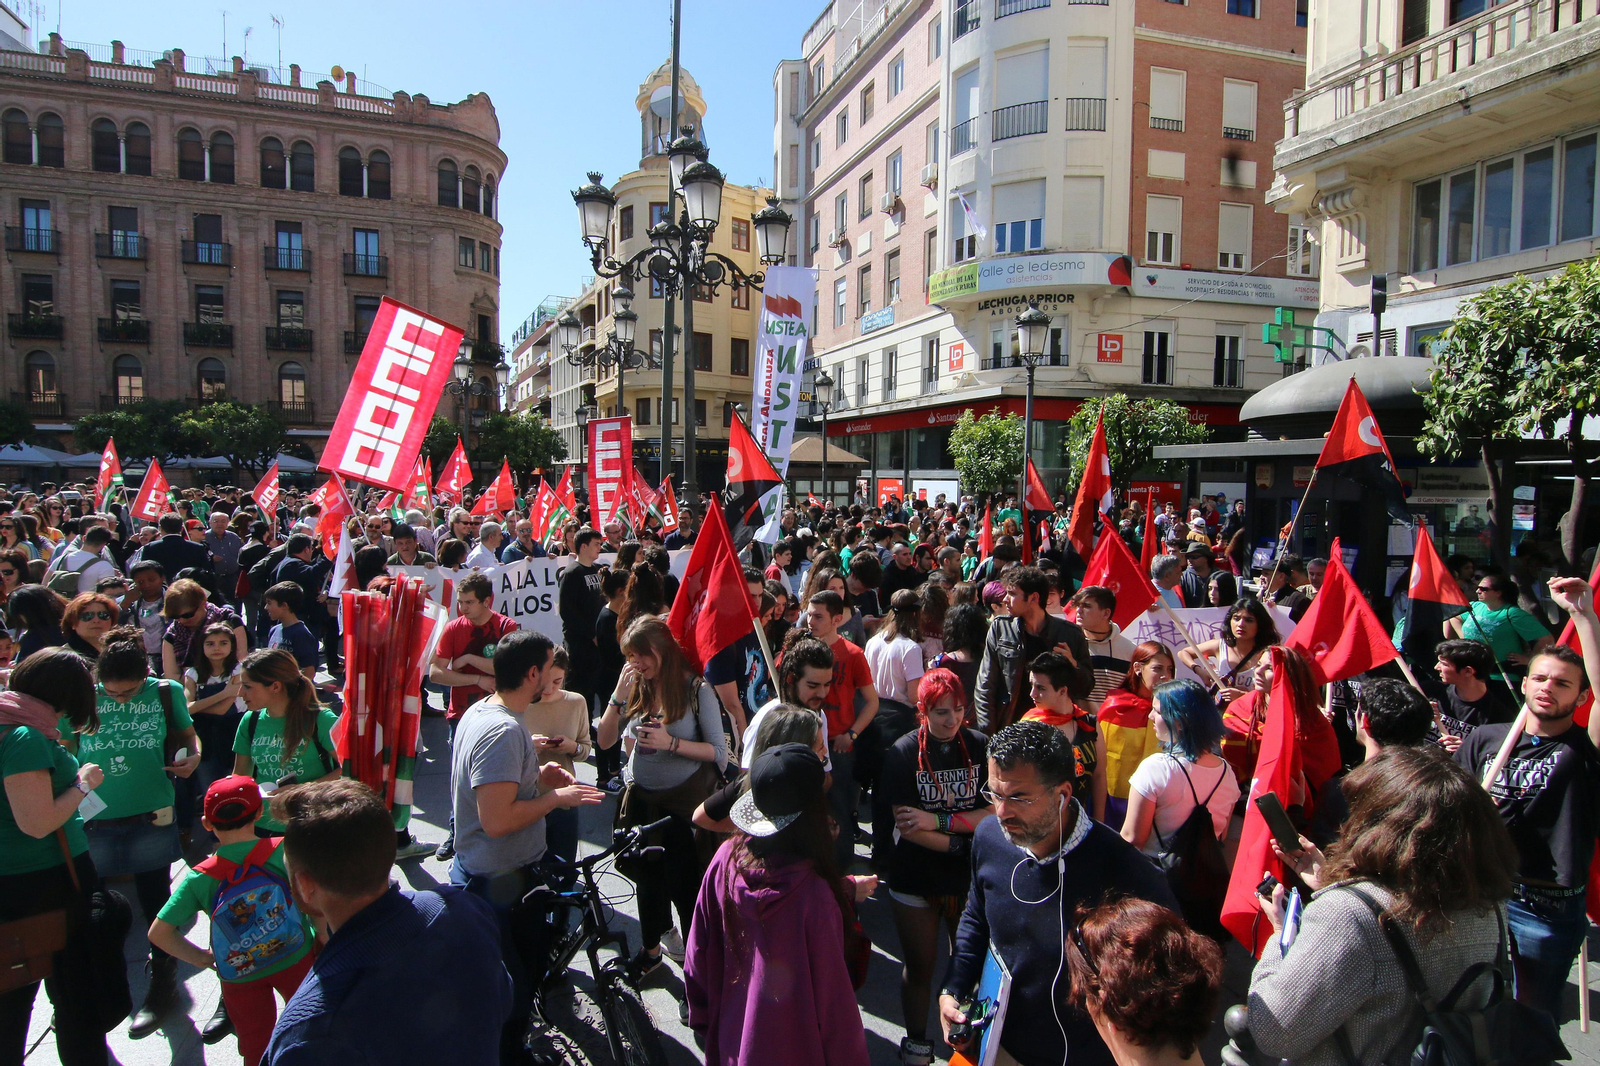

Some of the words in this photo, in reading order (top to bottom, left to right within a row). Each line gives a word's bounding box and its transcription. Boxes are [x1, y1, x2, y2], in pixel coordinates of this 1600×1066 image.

[1006, 261, 1025, 274] de
[1028, 259, 1086, 273] ledesma
[1006, 272, 1053, 284] asistencias
[1187, 278, 1211, 286] SERVICIO
[1218, 288, 1250, 297] RESIDENCIAS
[978, 294, 1075, 311] LECHUGA&PRIOR
[991, 304, 1058, 316] ABOGAOS
[766, 320, 807, 337] USTEA
[760, 348, 774, 418] ANDALUZA
[338, 306, 445, 482] CCOO
[798, 392, 812, 401] TON
[936, 409, 963, 423] Santande
[1186, 409, 1208, 421] nder
[851, 422, 871, 432] Santander
[501, 572, 512, 594] A
[516, 569, 538, 590] LA
[544, 566, 566, 588] LO
[514, 593, 552, 617] LOS
[96, 702, 125, 714] CUELA
[129, 700, 164, 714] PÚBLIC
[113, 721, 158, 732] TOD@S
[82, 740, 116, 754] PARA
[120, 739, 160, 750] TOD@S
[110, 763, 128, 773] 5%
